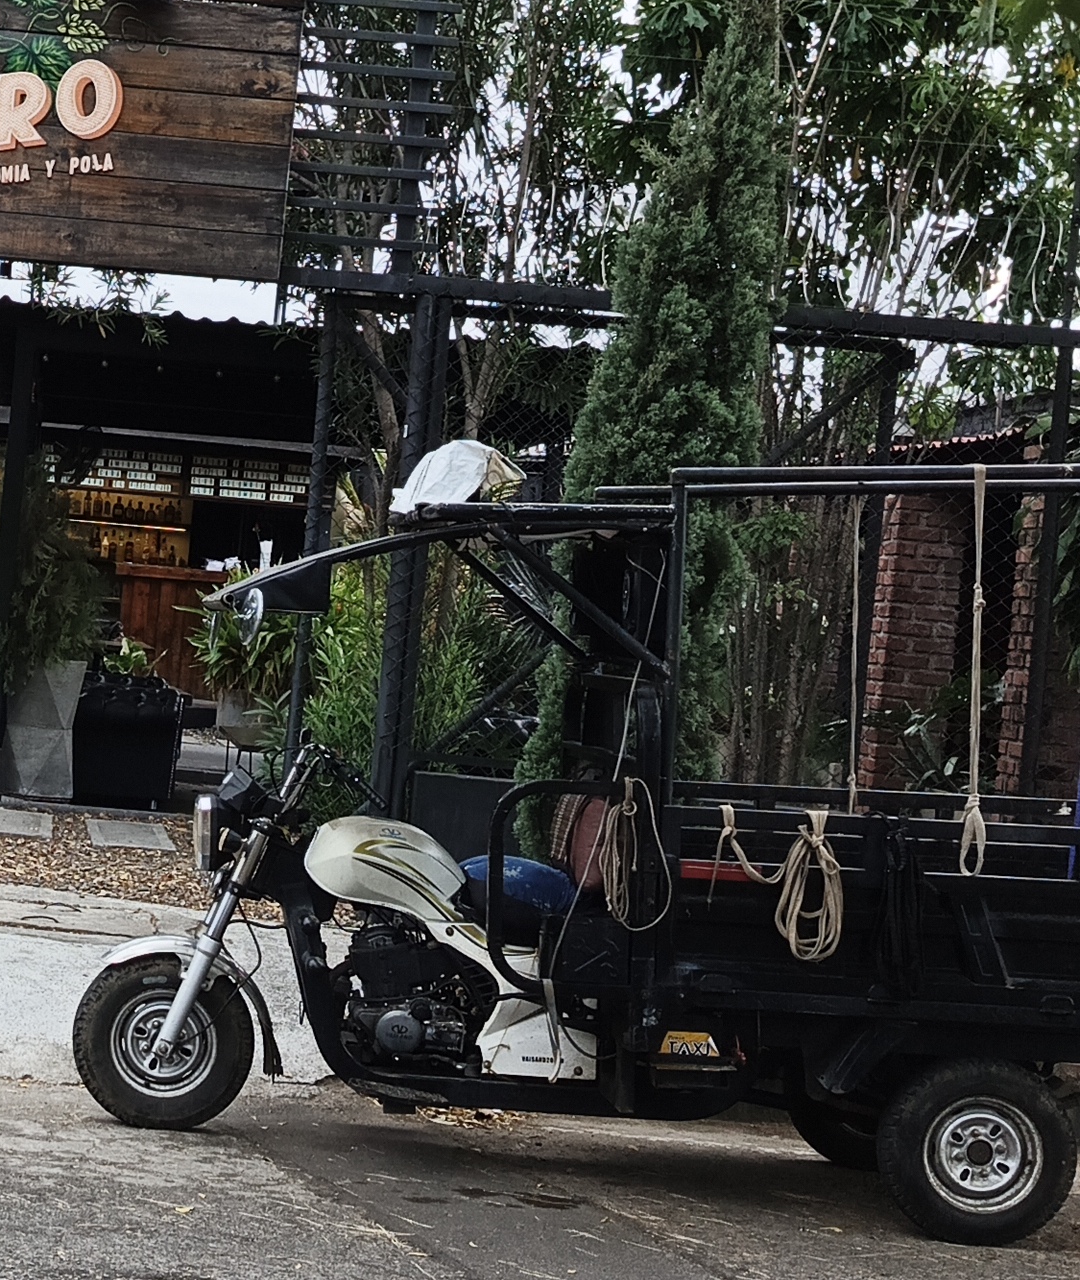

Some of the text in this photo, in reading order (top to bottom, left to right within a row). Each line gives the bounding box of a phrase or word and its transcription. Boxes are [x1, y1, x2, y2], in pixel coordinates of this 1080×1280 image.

[45, 159, 56, 178] Y
[69, 152, 114, 176] POLA
[668, 1039, 711, 1057] TAXI
